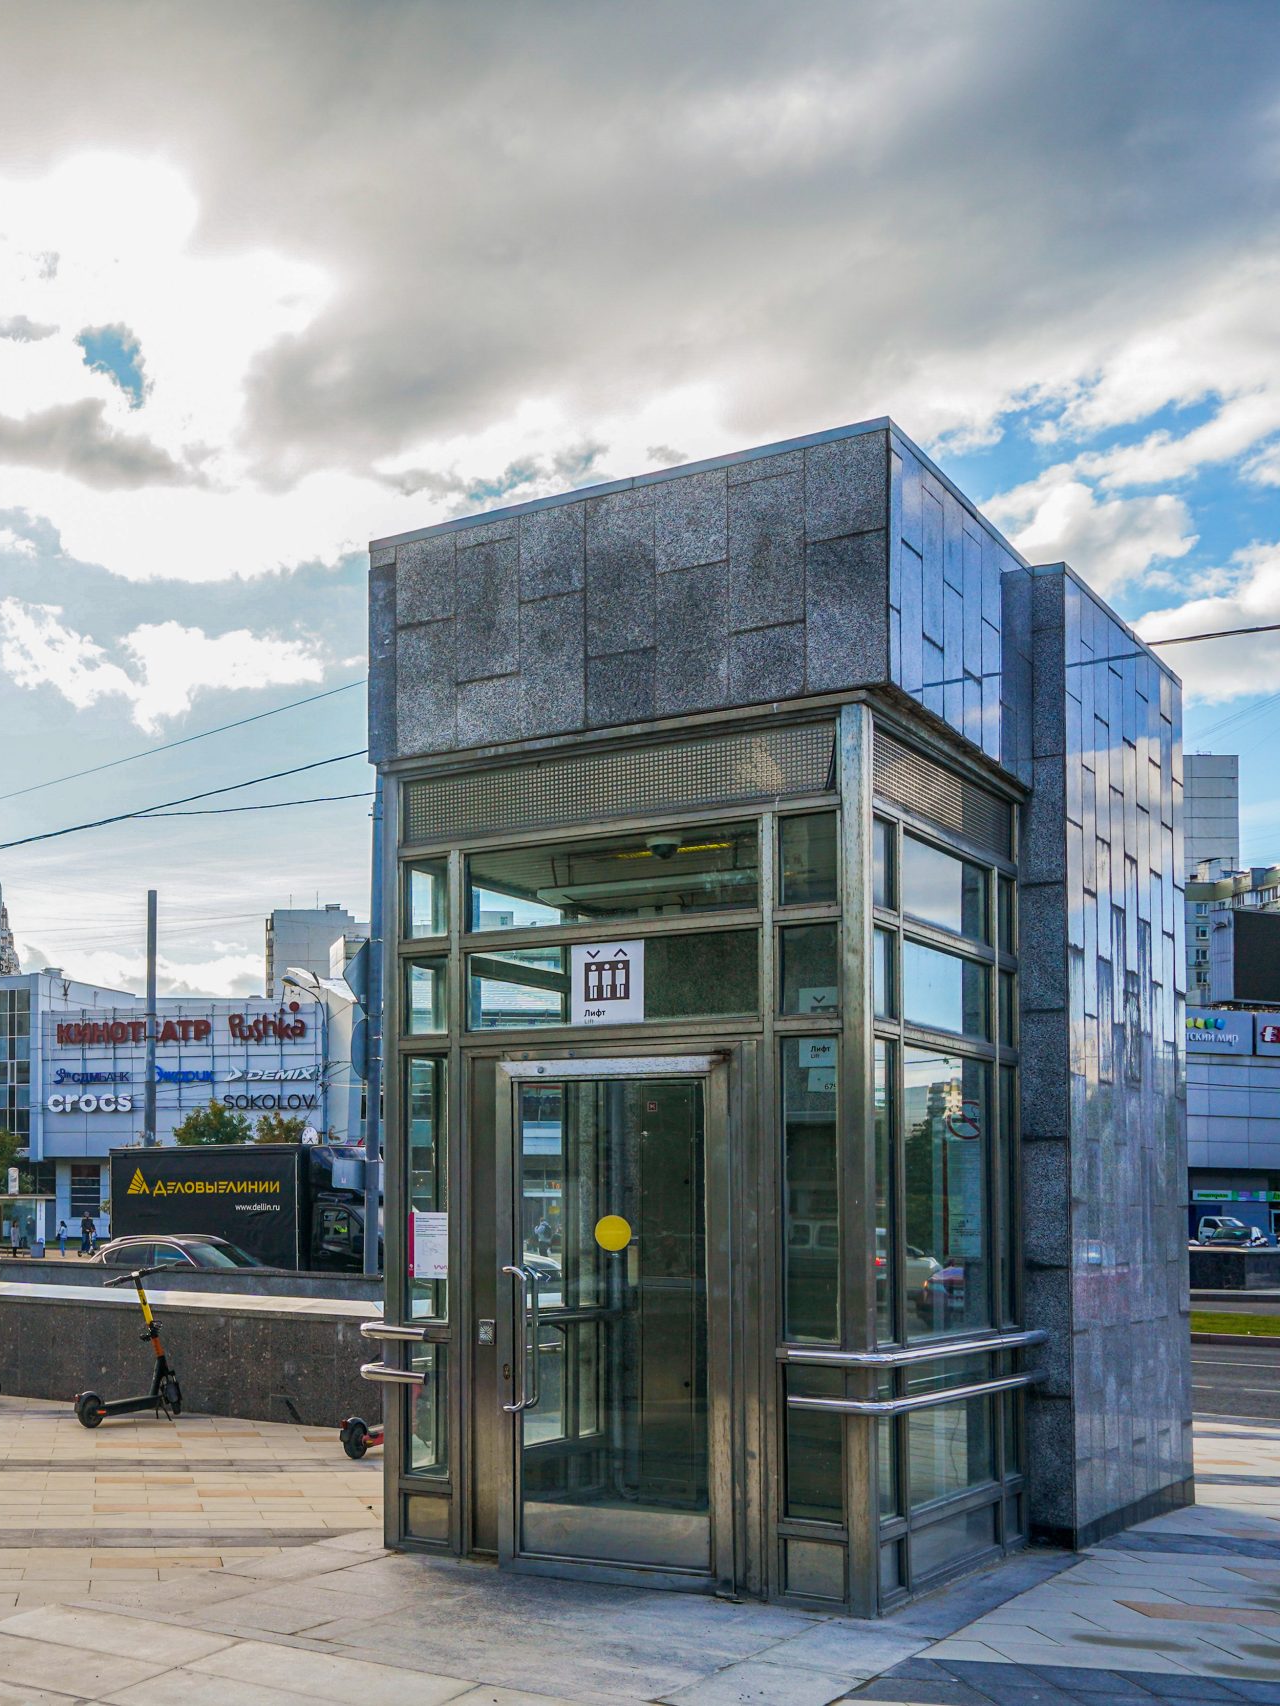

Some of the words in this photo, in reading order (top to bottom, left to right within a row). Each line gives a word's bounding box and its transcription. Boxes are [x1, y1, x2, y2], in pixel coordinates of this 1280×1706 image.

[584, 1009, 606, 1017] Лифт
[228, 1011, 306, 1041] Pushka
[1186, 1031, 1215, 1042] тский
[1217, 1034, 1239, 1046] мир
[810, 1044, 831, 1052] Лифт
[246, 1067, 317, 1080] DEMIX
[48, 1093, 132, 1113] crocs
[223, 1094, 315, 1110] SOKOLOV
[235, 1203, 281, 1211] www.dellin.ru
